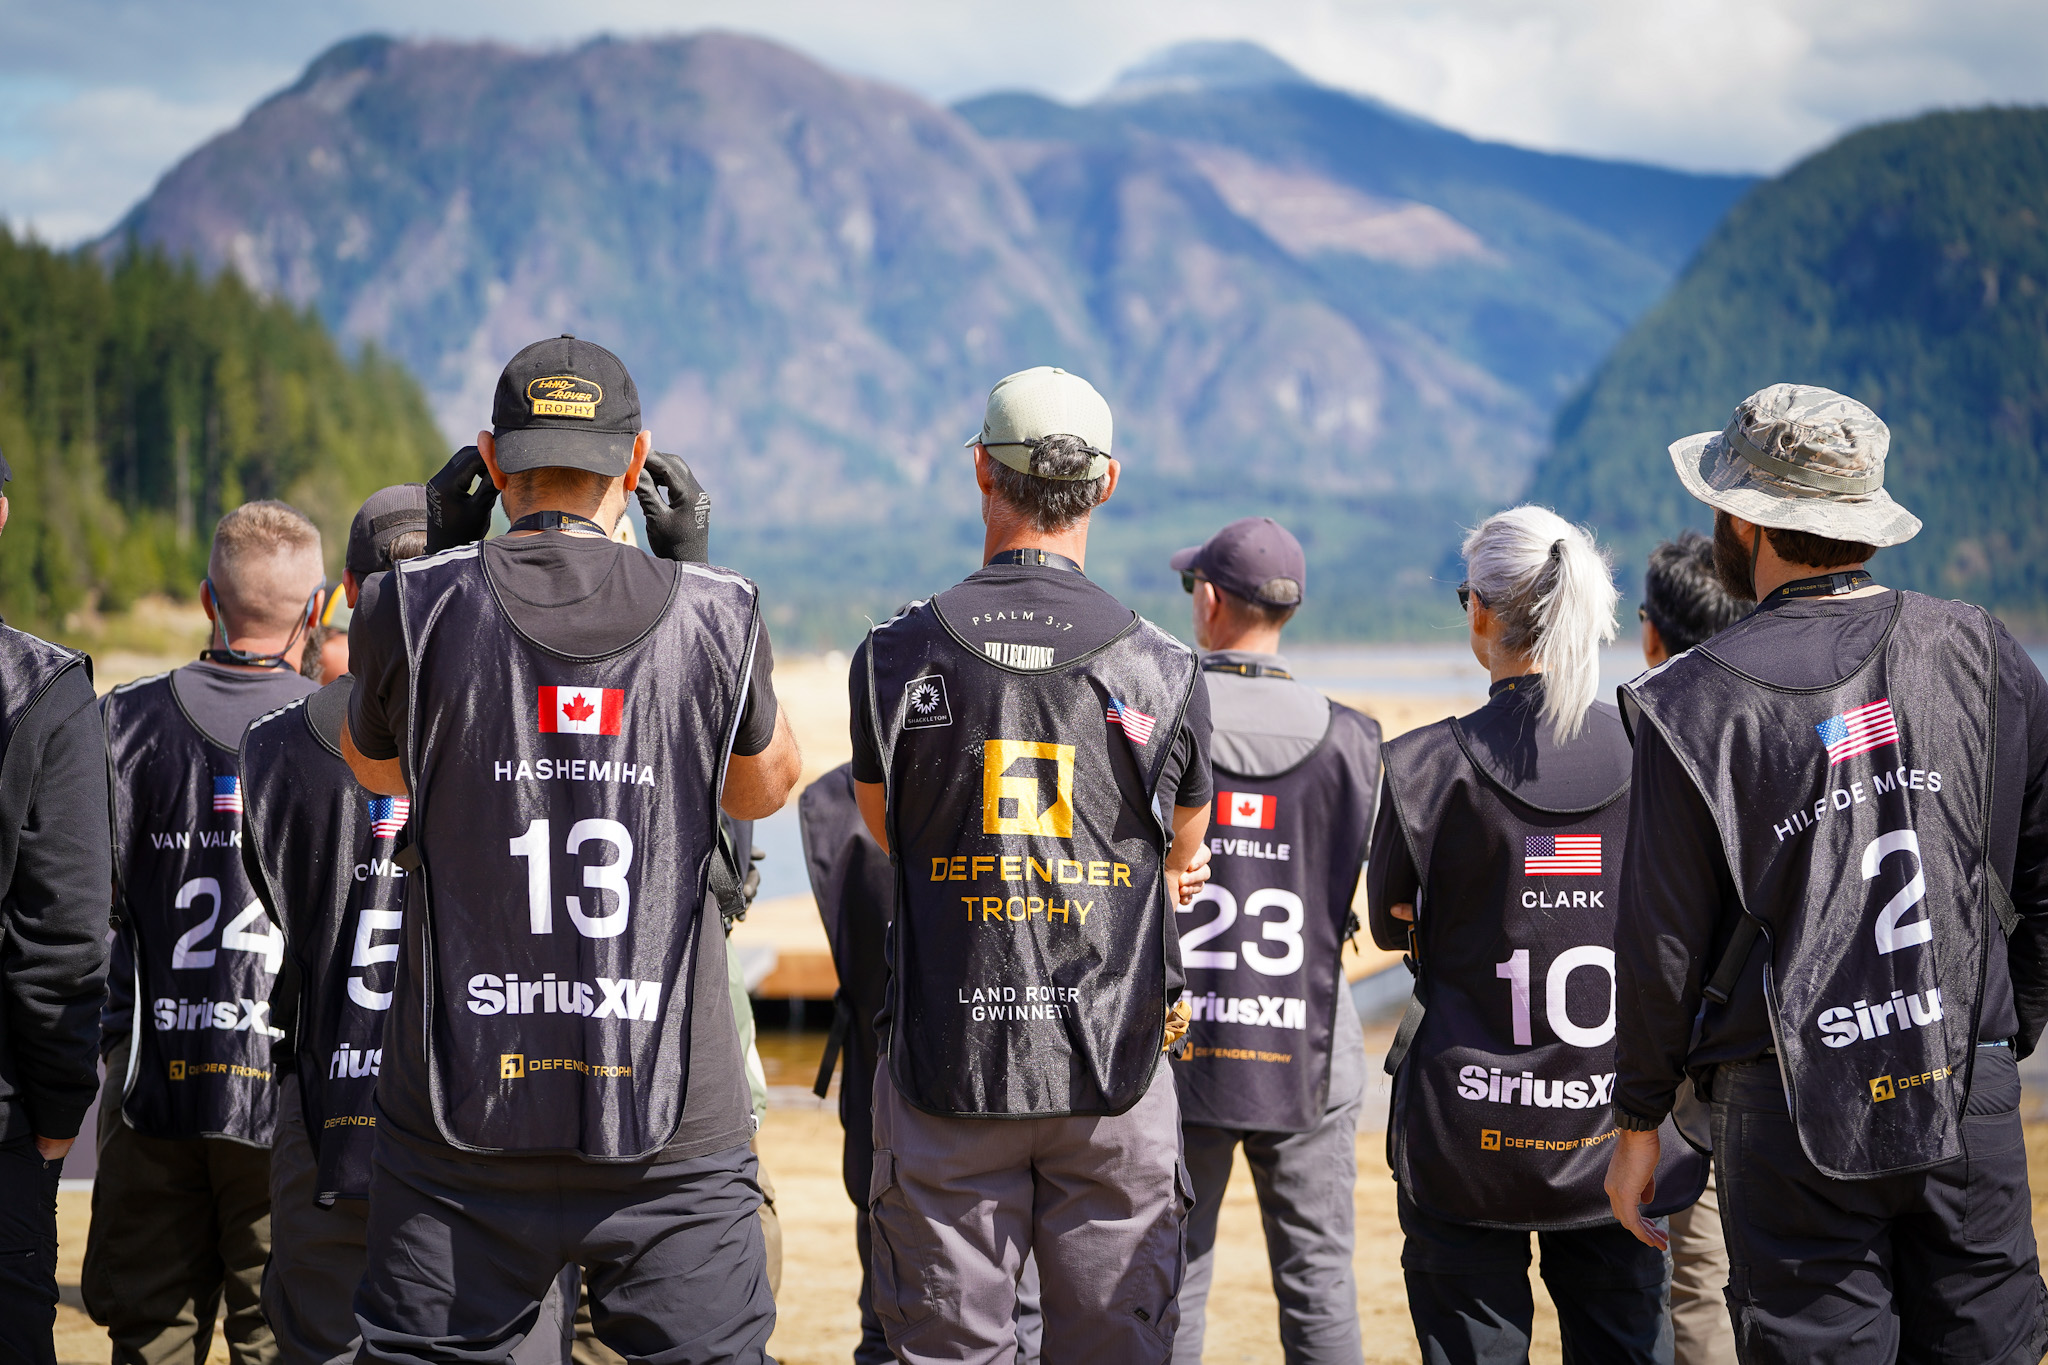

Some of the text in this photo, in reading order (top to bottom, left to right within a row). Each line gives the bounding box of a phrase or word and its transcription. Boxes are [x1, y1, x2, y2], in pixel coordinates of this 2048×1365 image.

[538, 380, 573, 389] LAND
[549, 391, 593, 402] ROVER
[536, 404, 592, 415] TROPHY
[972, 611, 1074, 632] PSALM 3:7
[908, 714, 948, 724] SHACKLETON
[494, 759, 656, 787] HASHEMIHA
[1832, 782, 1866, 811] DE
[151, 831, 191, 849] VAN
[509, 818, 634, 938] 13
[930, 856, 1132, 887] DEFENDER
[1521, 890, 1604, 909] CLARK
[1862, 829, 1933, 955] 2
[961, 896, 1094, 925] TROPHY
[172, 877, 285, 975] 24
[1176, 883, 1305, 977] 23
[347, 909, 403, 1011] 5
[958, 986, 1080, 1003] LAND ROVER
[1495, 945, 1616, 1048] 10
[1817, 987, 1944, 1048] Siriu
[230, 1064, 272, 1081] TROPHY
[1457, 1064, 1617, 1110] SiriusX
[1505, 1137, 1579, 1151] DEFENDER
